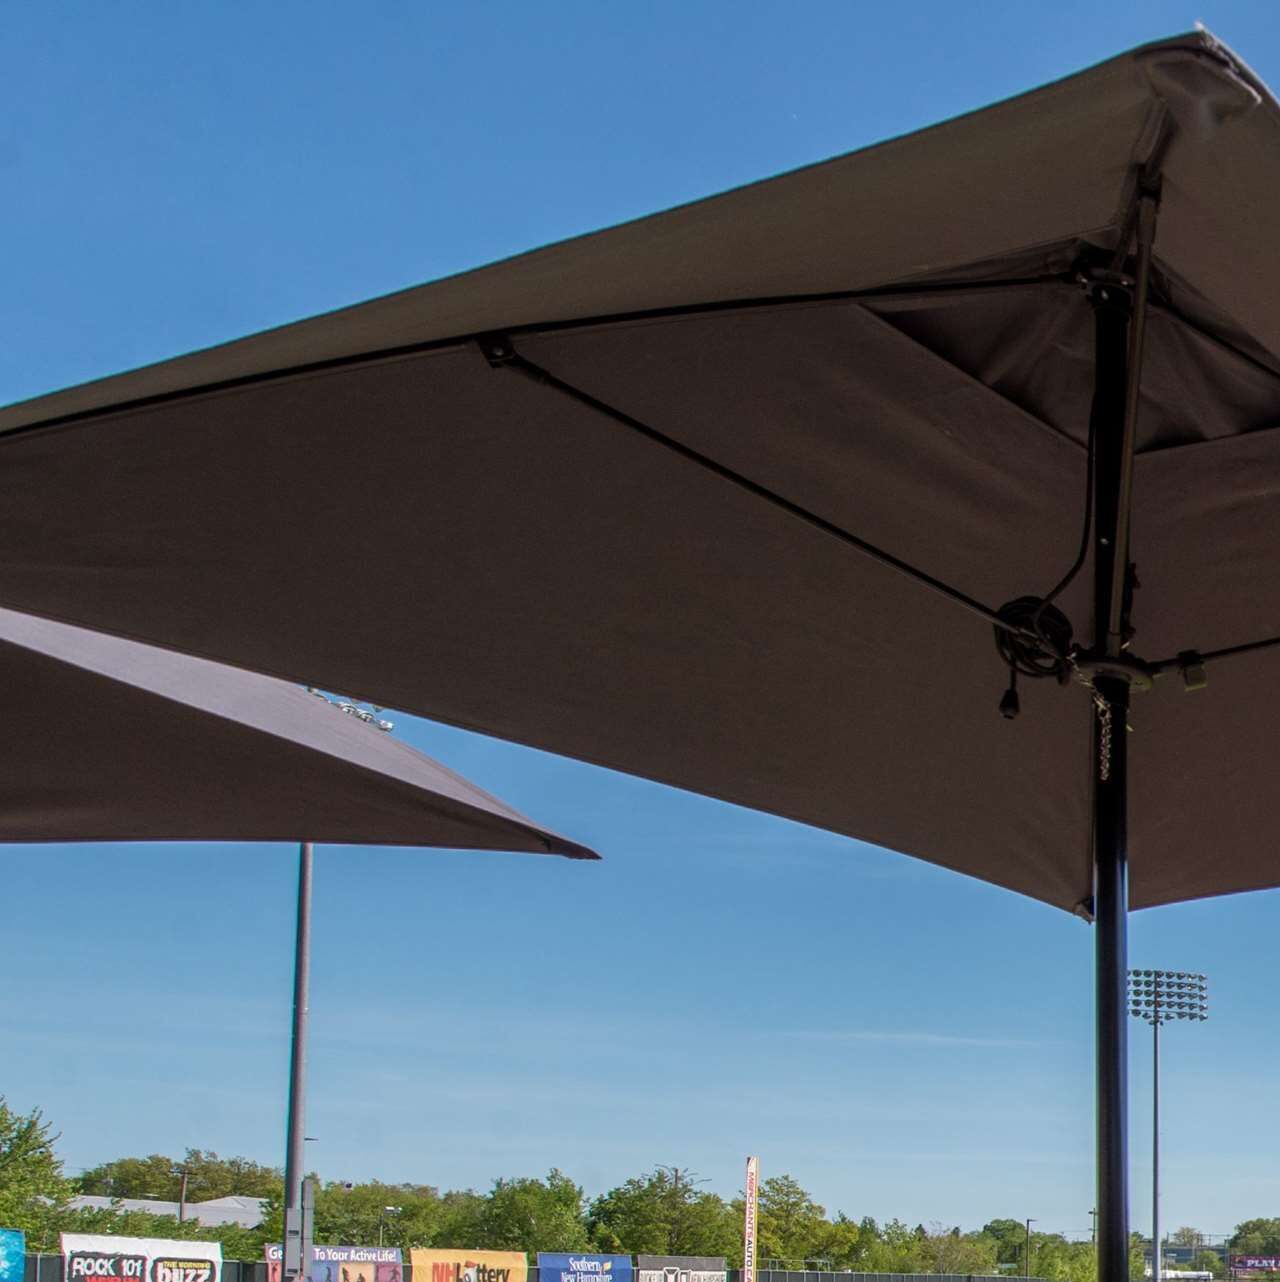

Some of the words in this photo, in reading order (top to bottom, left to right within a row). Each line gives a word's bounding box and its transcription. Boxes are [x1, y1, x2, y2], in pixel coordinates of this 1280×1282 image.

[314, 1248, 326, 1261] To
[327, 1248, 348, 1262] Your
[350, 1248, 376, 1262] Active
[377, 1249, 397, 1262] Life!
[72, 1256, 115, 1278] ROCK
[120, 1258, 142, 1277] 101
[569, 1256, 601, 1272] Southern
[1247, 1259, 1275, 1267] PLAY
